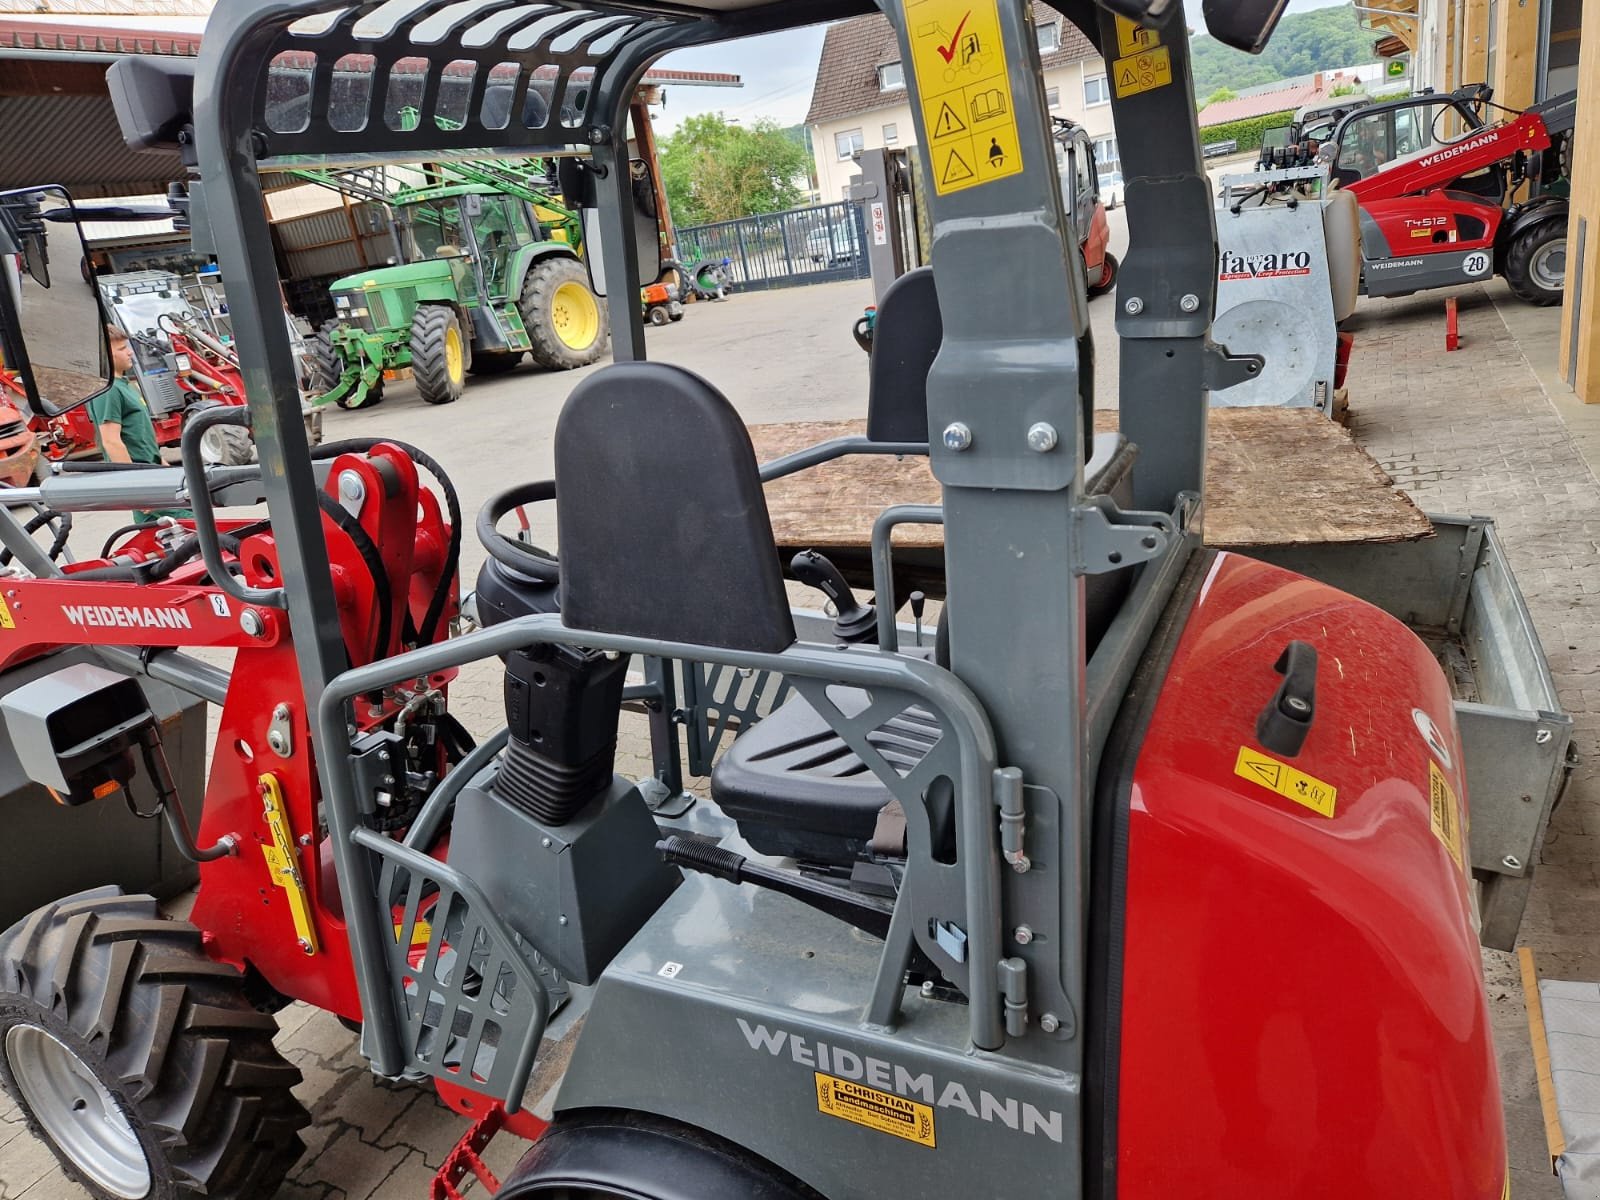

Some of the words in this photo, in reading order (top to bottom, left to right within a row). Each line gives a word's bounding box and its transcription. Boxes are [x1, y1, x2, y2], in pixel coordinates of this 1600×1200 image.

[1419, 133, 1498, 167] WEIDEMANN
[1404, 216, 1447, 228] T4512
[1220, 250, 1310, 277] favaro
[1371, 259, 1424, 270] WEIDEMANN
[1468, 256, 1484, 272] 20
[61, 604, 192, 629] WEIDEMANN
[736, 1017, 1063, 1144] WEIDEMANN
[838, 1092, 912, 1121] Landmaschinen
